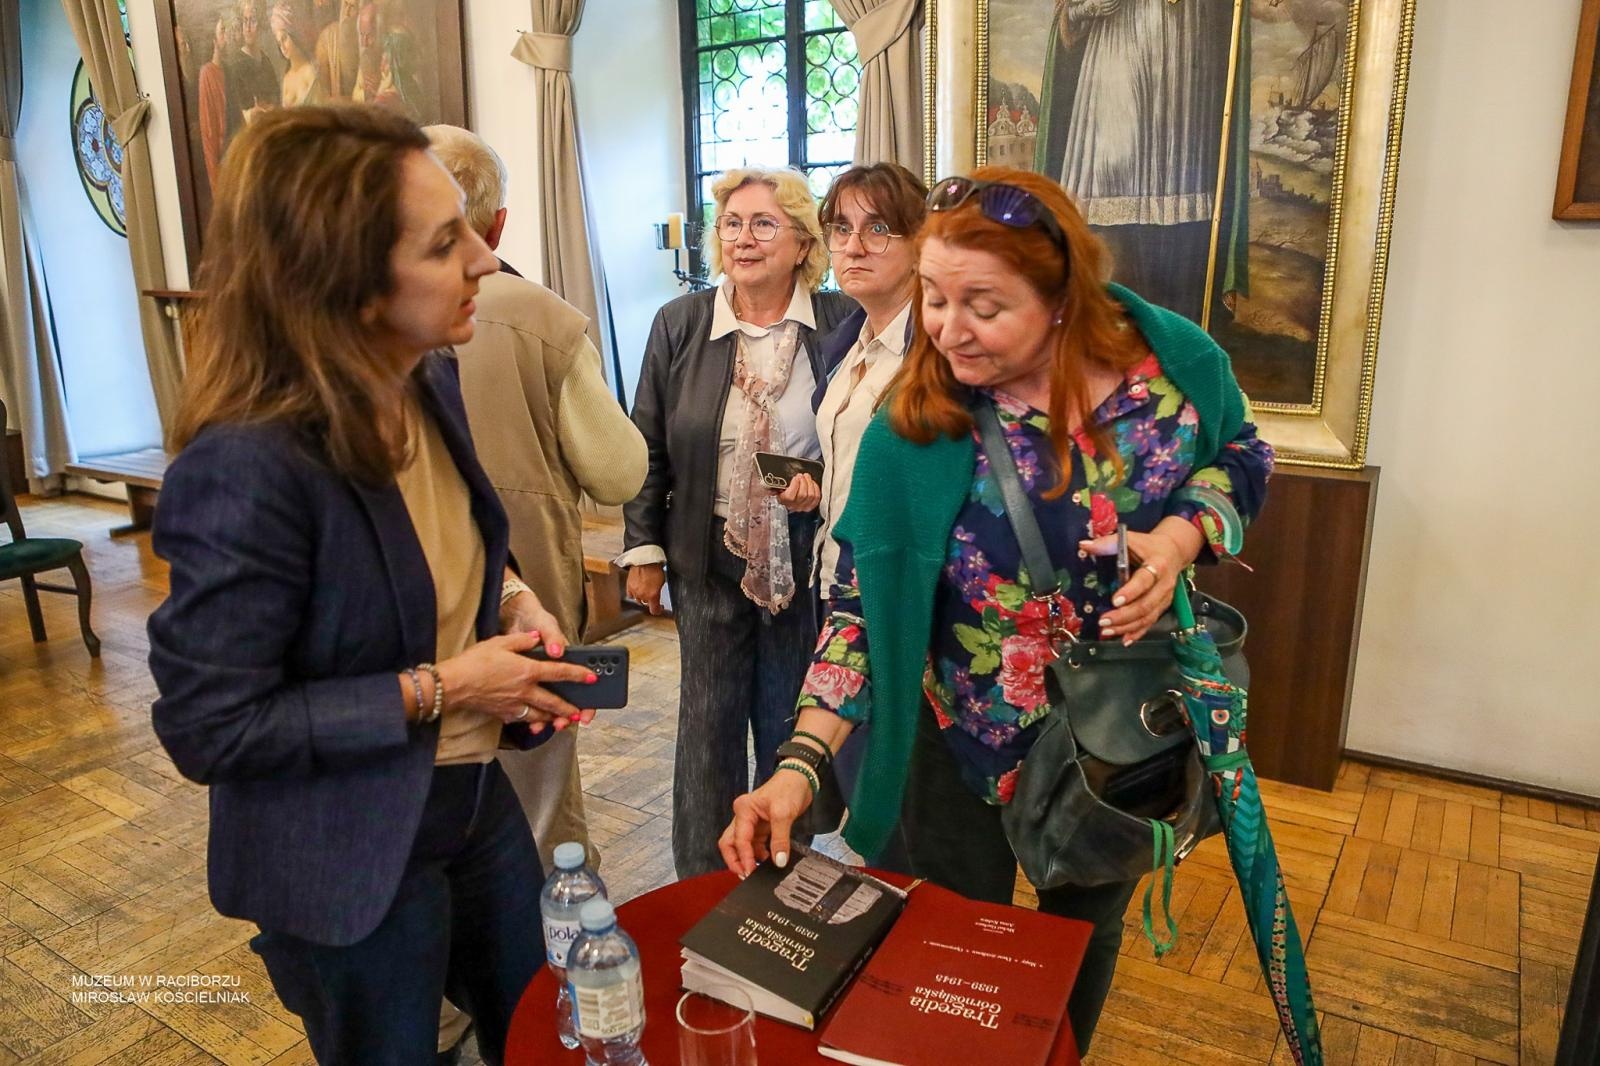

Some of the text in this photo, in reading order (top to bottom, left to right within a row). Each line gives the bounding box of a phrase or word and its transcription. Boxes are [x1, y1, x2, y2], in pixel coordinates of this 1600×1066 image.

[737, 926, 810, 972] Tragedia
[745, 918, 815, 959] Górnośląska
[909, 996, 999, 1029] Tragedia
[915, 986, 1001, 1014] Górnośląska
